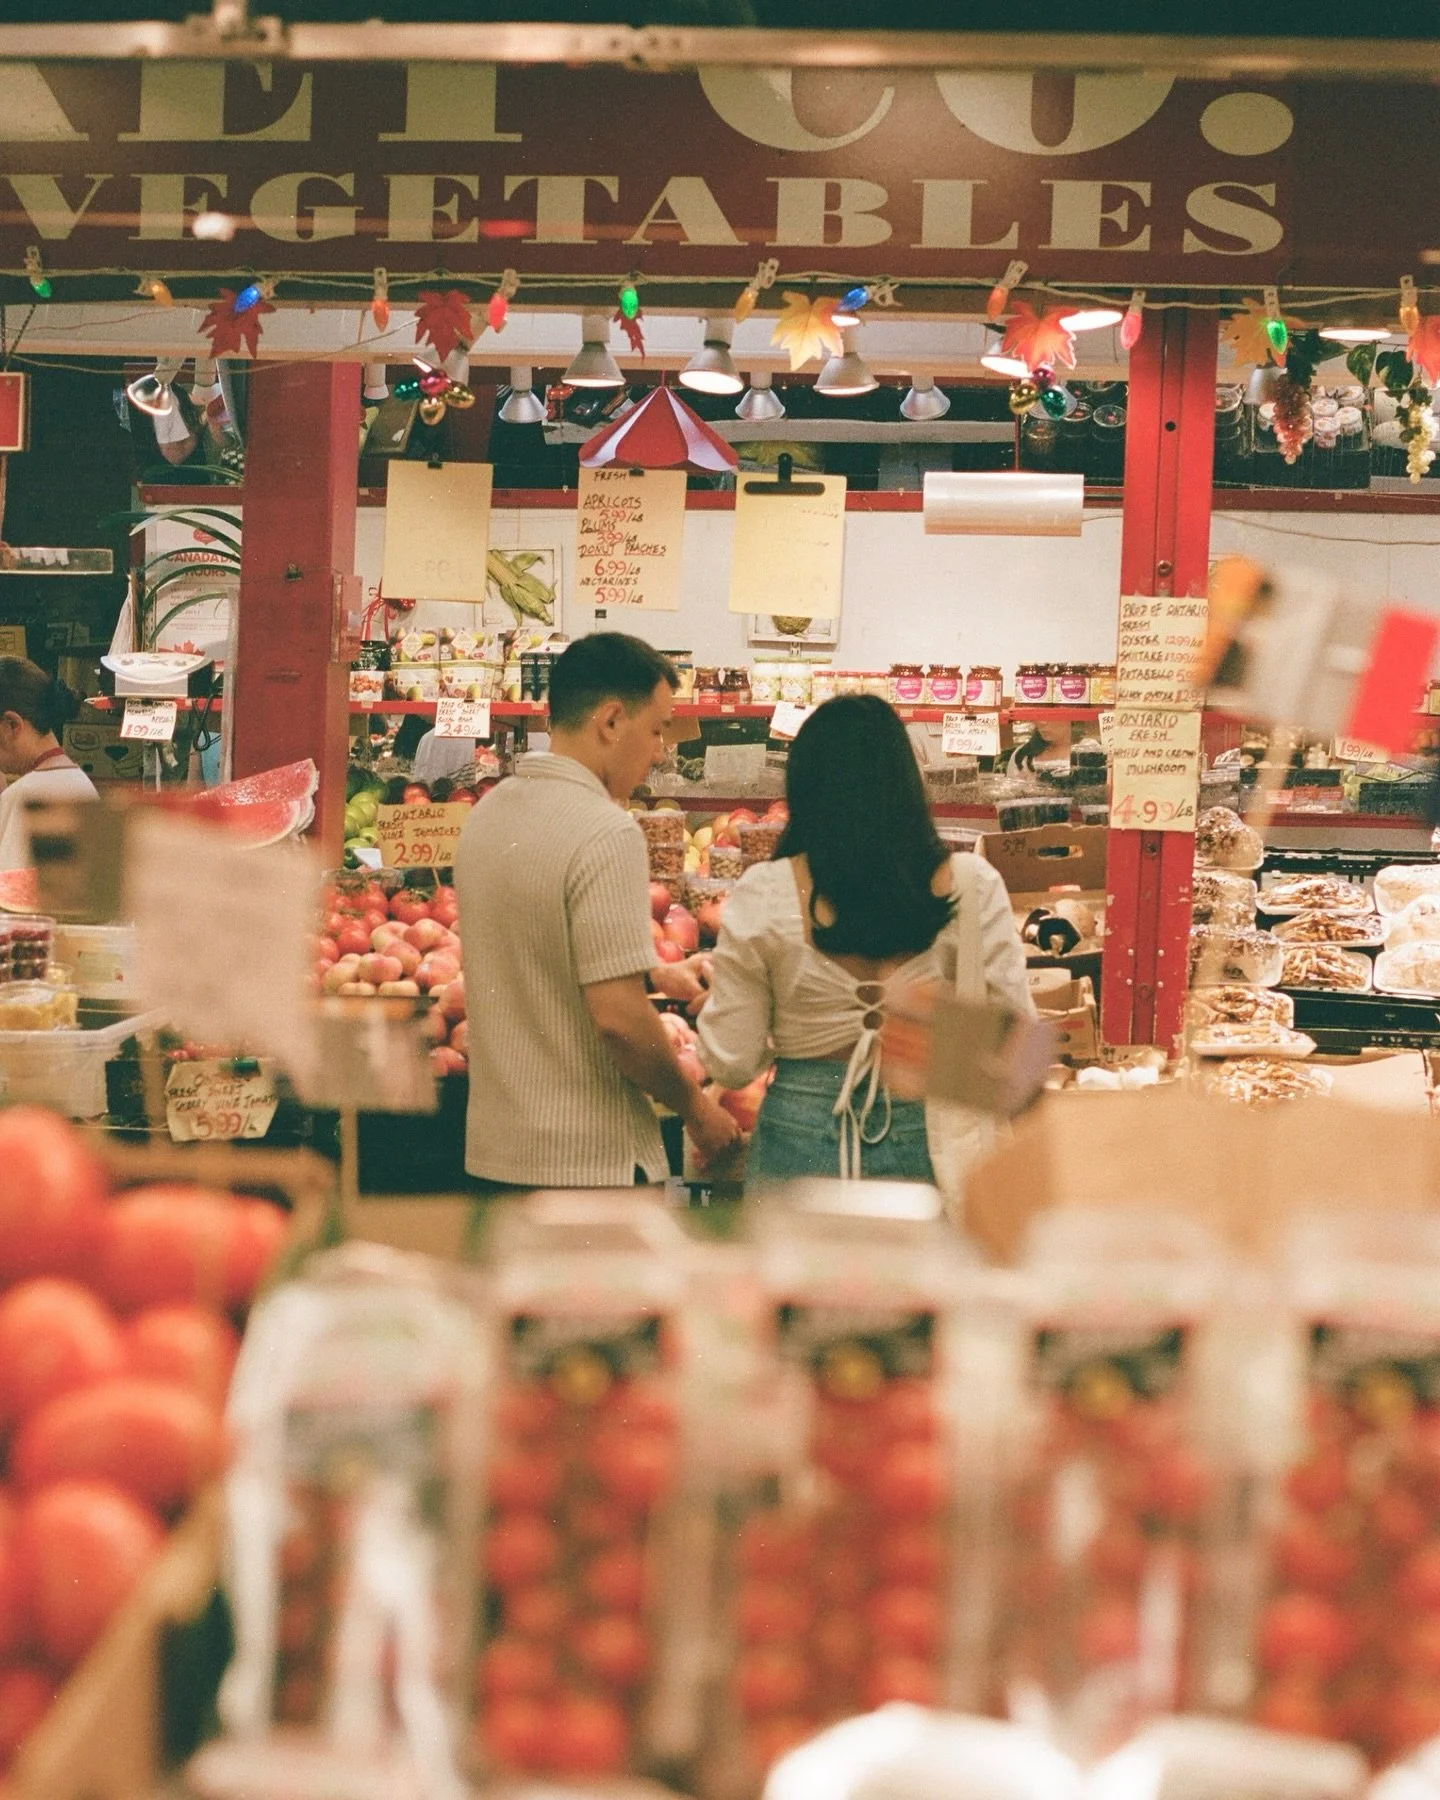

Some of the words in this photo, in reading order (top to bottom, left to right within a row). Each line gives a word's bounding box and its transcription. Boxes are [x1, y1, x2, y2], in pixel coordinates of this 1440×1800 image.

[2, 173, 1285, 255] VEGETABLES
[594, 471, 627, 481] FRESH
[583, 494, 641, 509] APRICOTS
[1119, 712, 1179, 728] ONTARIO
[1128, 729, 1173, 741] FRESH
[393, 808, 446, 822] ONTARIO
